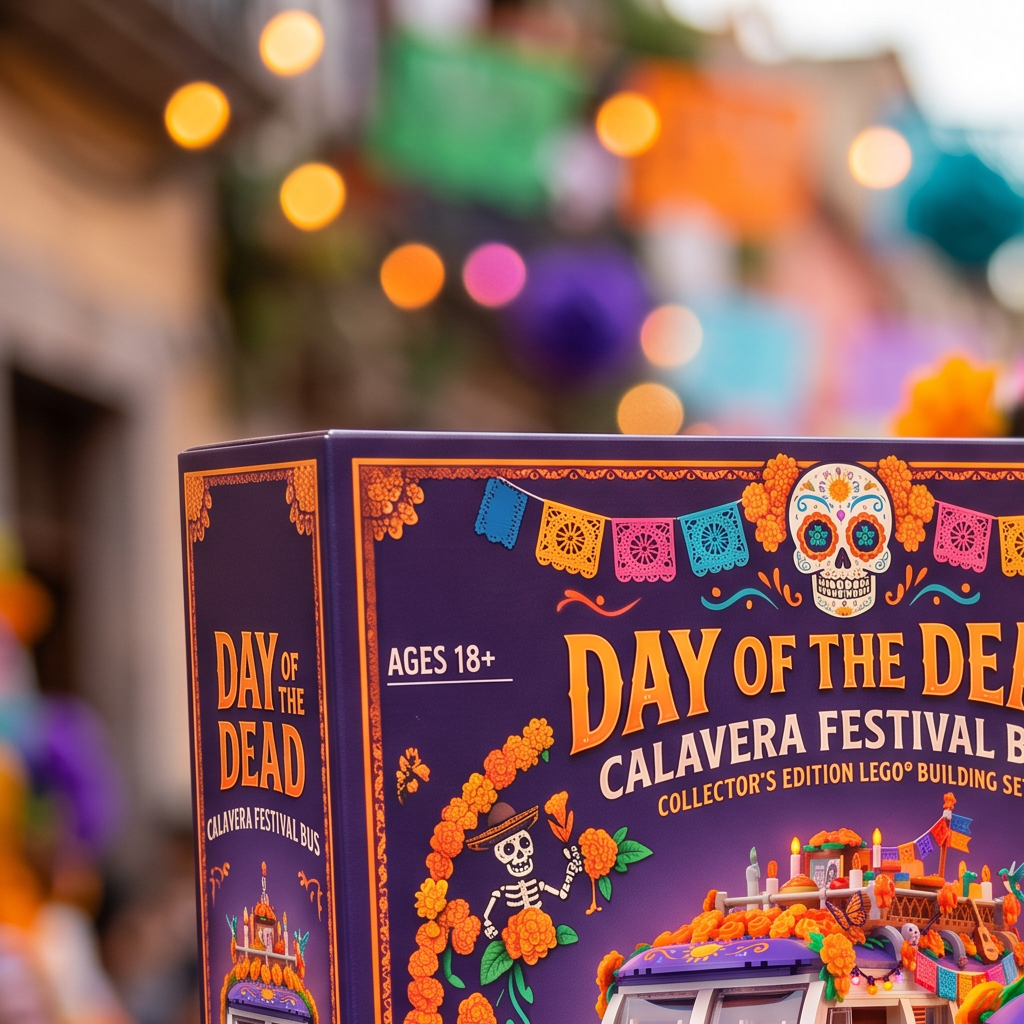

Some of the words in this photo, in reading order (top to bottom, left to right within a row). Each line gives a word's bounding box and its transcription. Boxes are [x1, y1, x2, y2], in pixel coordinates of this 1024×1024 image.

[214, 631, 278, 710] DAY
[281, 651, 299, 681] OF
[388, 645, 447, 676] AGES
[454, 644, 496, 673] 18+
[278, 686, 305, 716] THE
[563, 628, 722, 756] DAY
[733, 635, 796, 696] OF
[809, 632, 906, 690] THE
[218, 721, 306, 798] DEAD
[599, 713, 807, 800] CALAVERA
[818, 709, 995, 759] FESTIVAL
[658, 770, 777, 817] COLLECTOR'S
[782, 762, 854, 789] EDITION
[918, 763, 998, 792] BUILDING
[207, 807, 252, 841] CALAVERA
[254, 807, 299, 843] FESTIVAL
[300, 822, 321, 856] BUS
